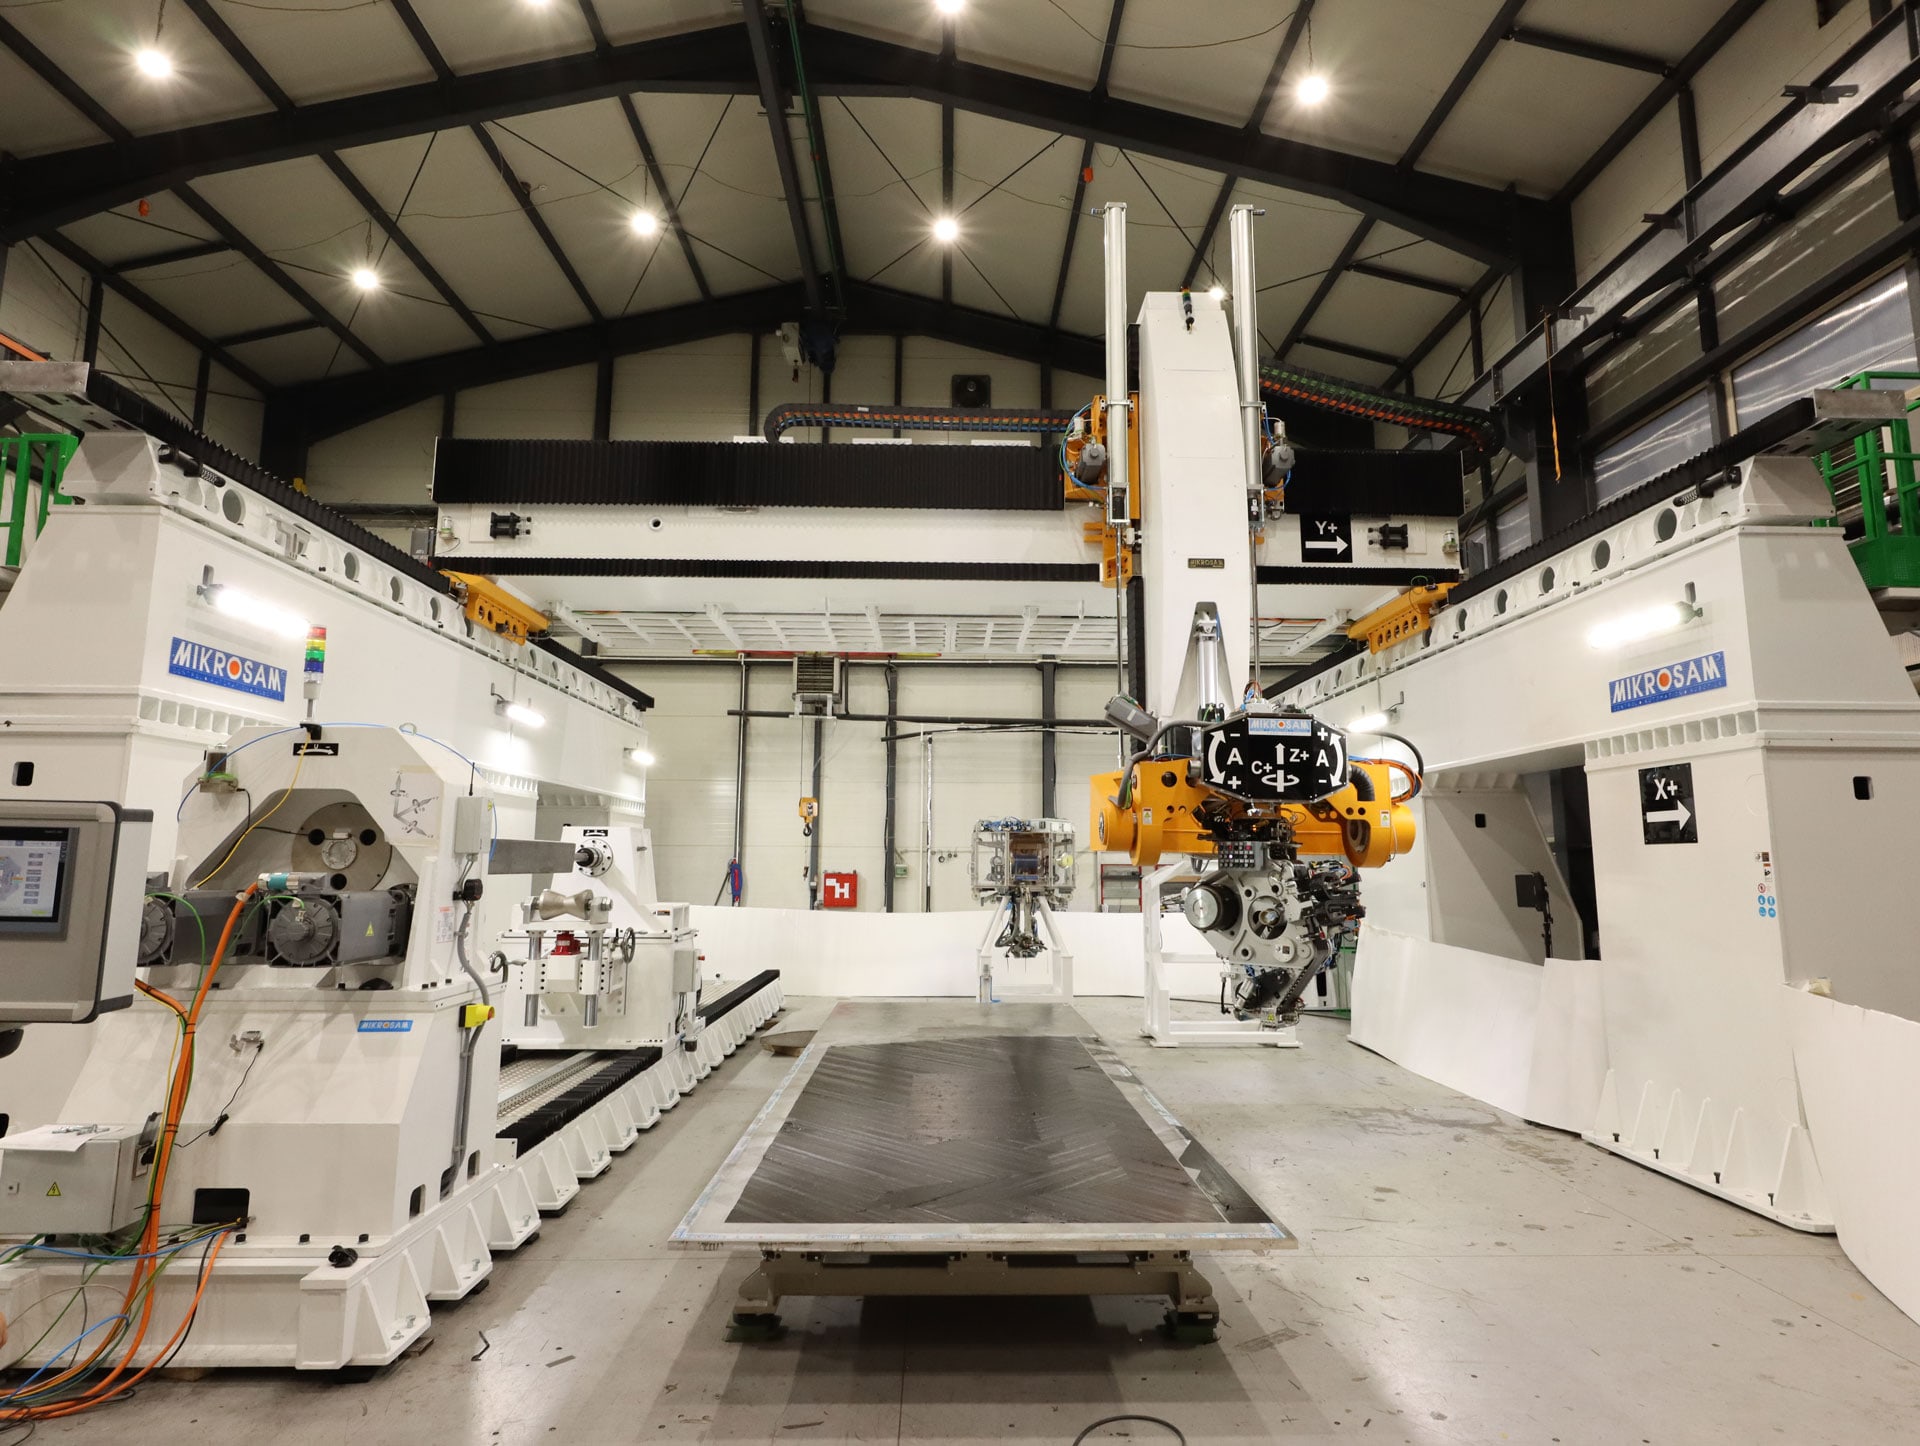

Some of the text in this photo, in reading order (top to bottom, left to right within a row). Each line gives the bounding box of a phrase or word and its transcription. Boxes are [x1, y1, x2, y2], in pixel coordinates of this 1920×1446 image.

[1314, 520, 1338, 535] Y+
[172, 640, 282, 692] MIKROSAM
[1612, 655, 1721, 704] MIKROSAM
[1250, 718, 1310, 729] MIKROSAM
[1226, 747, 1244, 766] A
[1289, 748, 1310, 762] Z+
[1315, 749, 1330, 768] A
[1251, 760, 1273, 775] C+
[1654, 777, 1678, 800] X+
[834, 882, 850, 899] H
